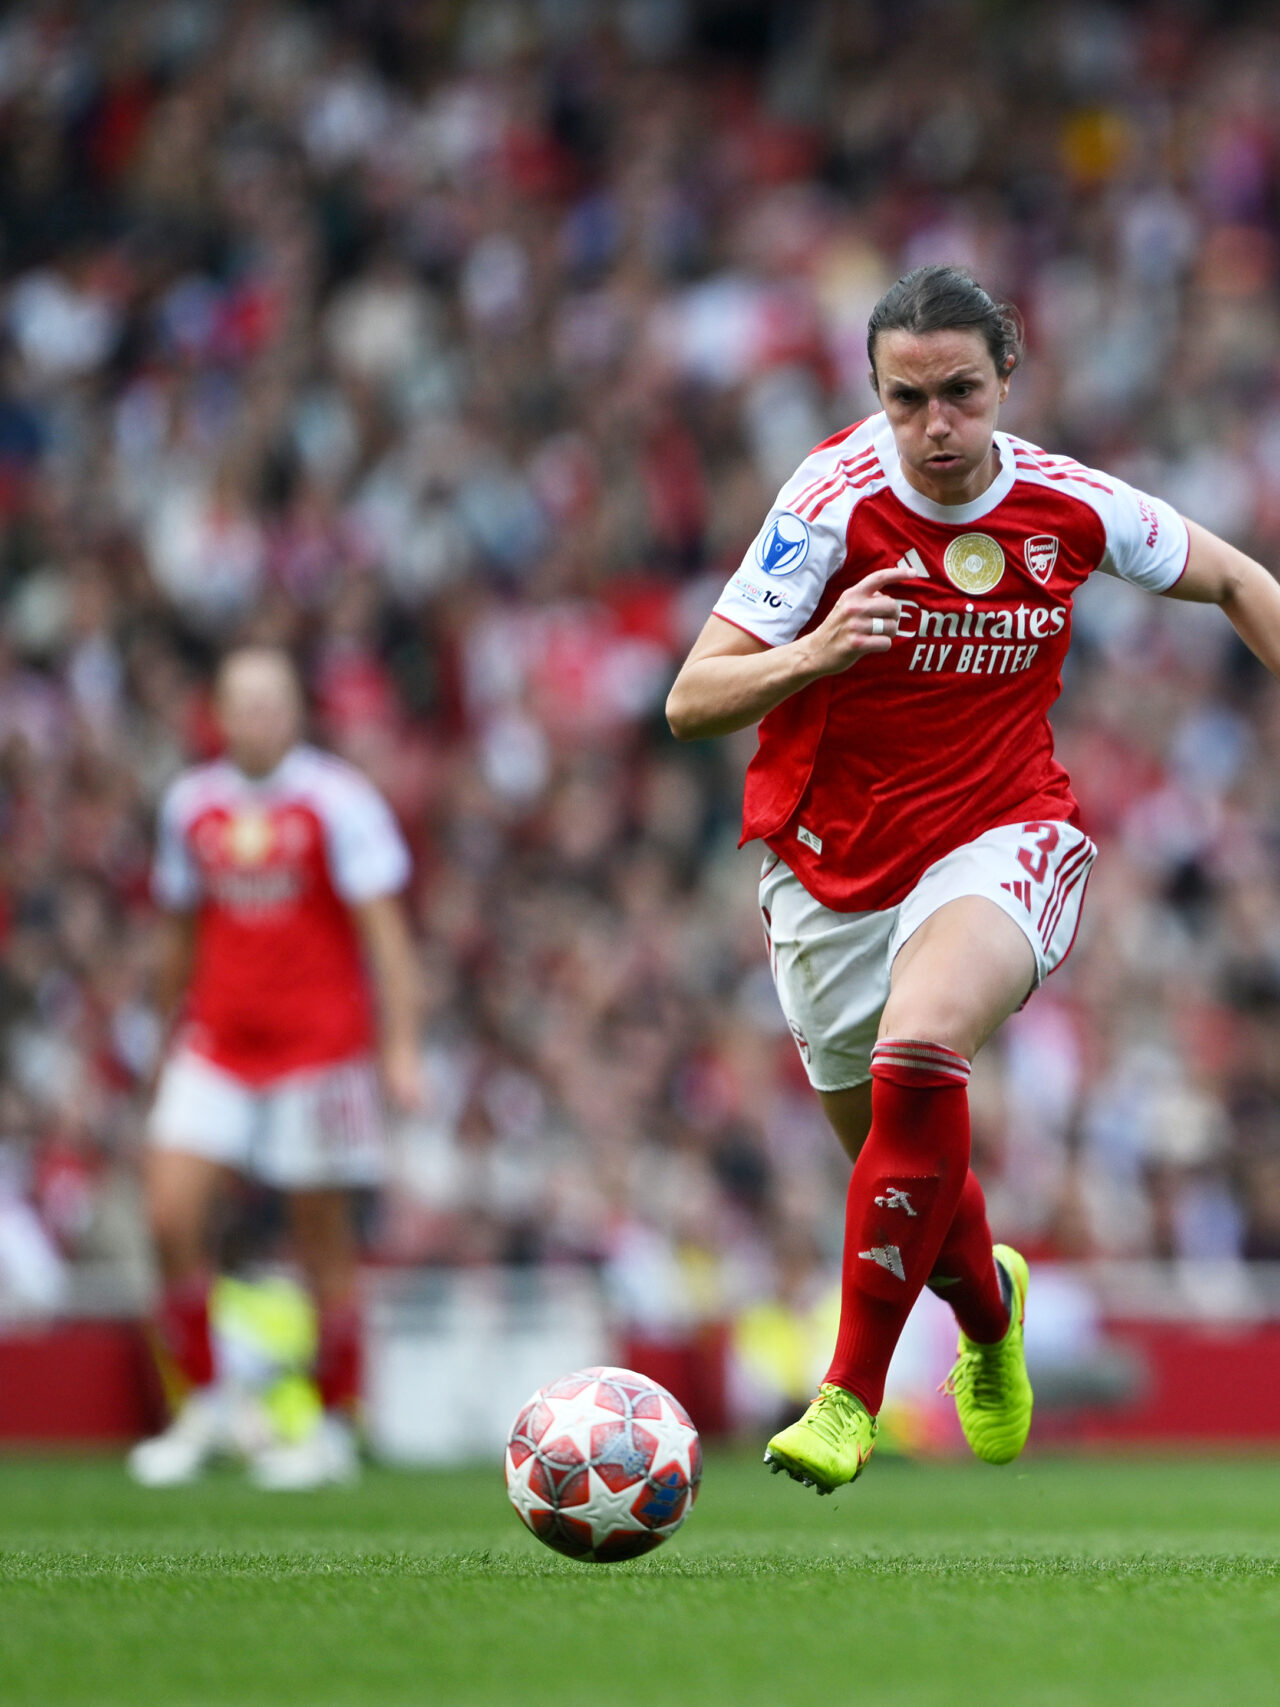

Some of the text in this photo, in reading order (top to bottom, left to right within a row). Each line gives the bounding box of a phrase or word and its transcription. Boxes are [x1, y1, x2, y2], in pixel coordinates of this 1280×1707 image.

[1030, 542, 1055, 553] Arsenal
[763, 590, 782, 608] 10
[895, 599, 1067, 640] Emirates
[908, 643, 1039, 674] FLY BETTER
[1016, 822, 1060, 884] 3
